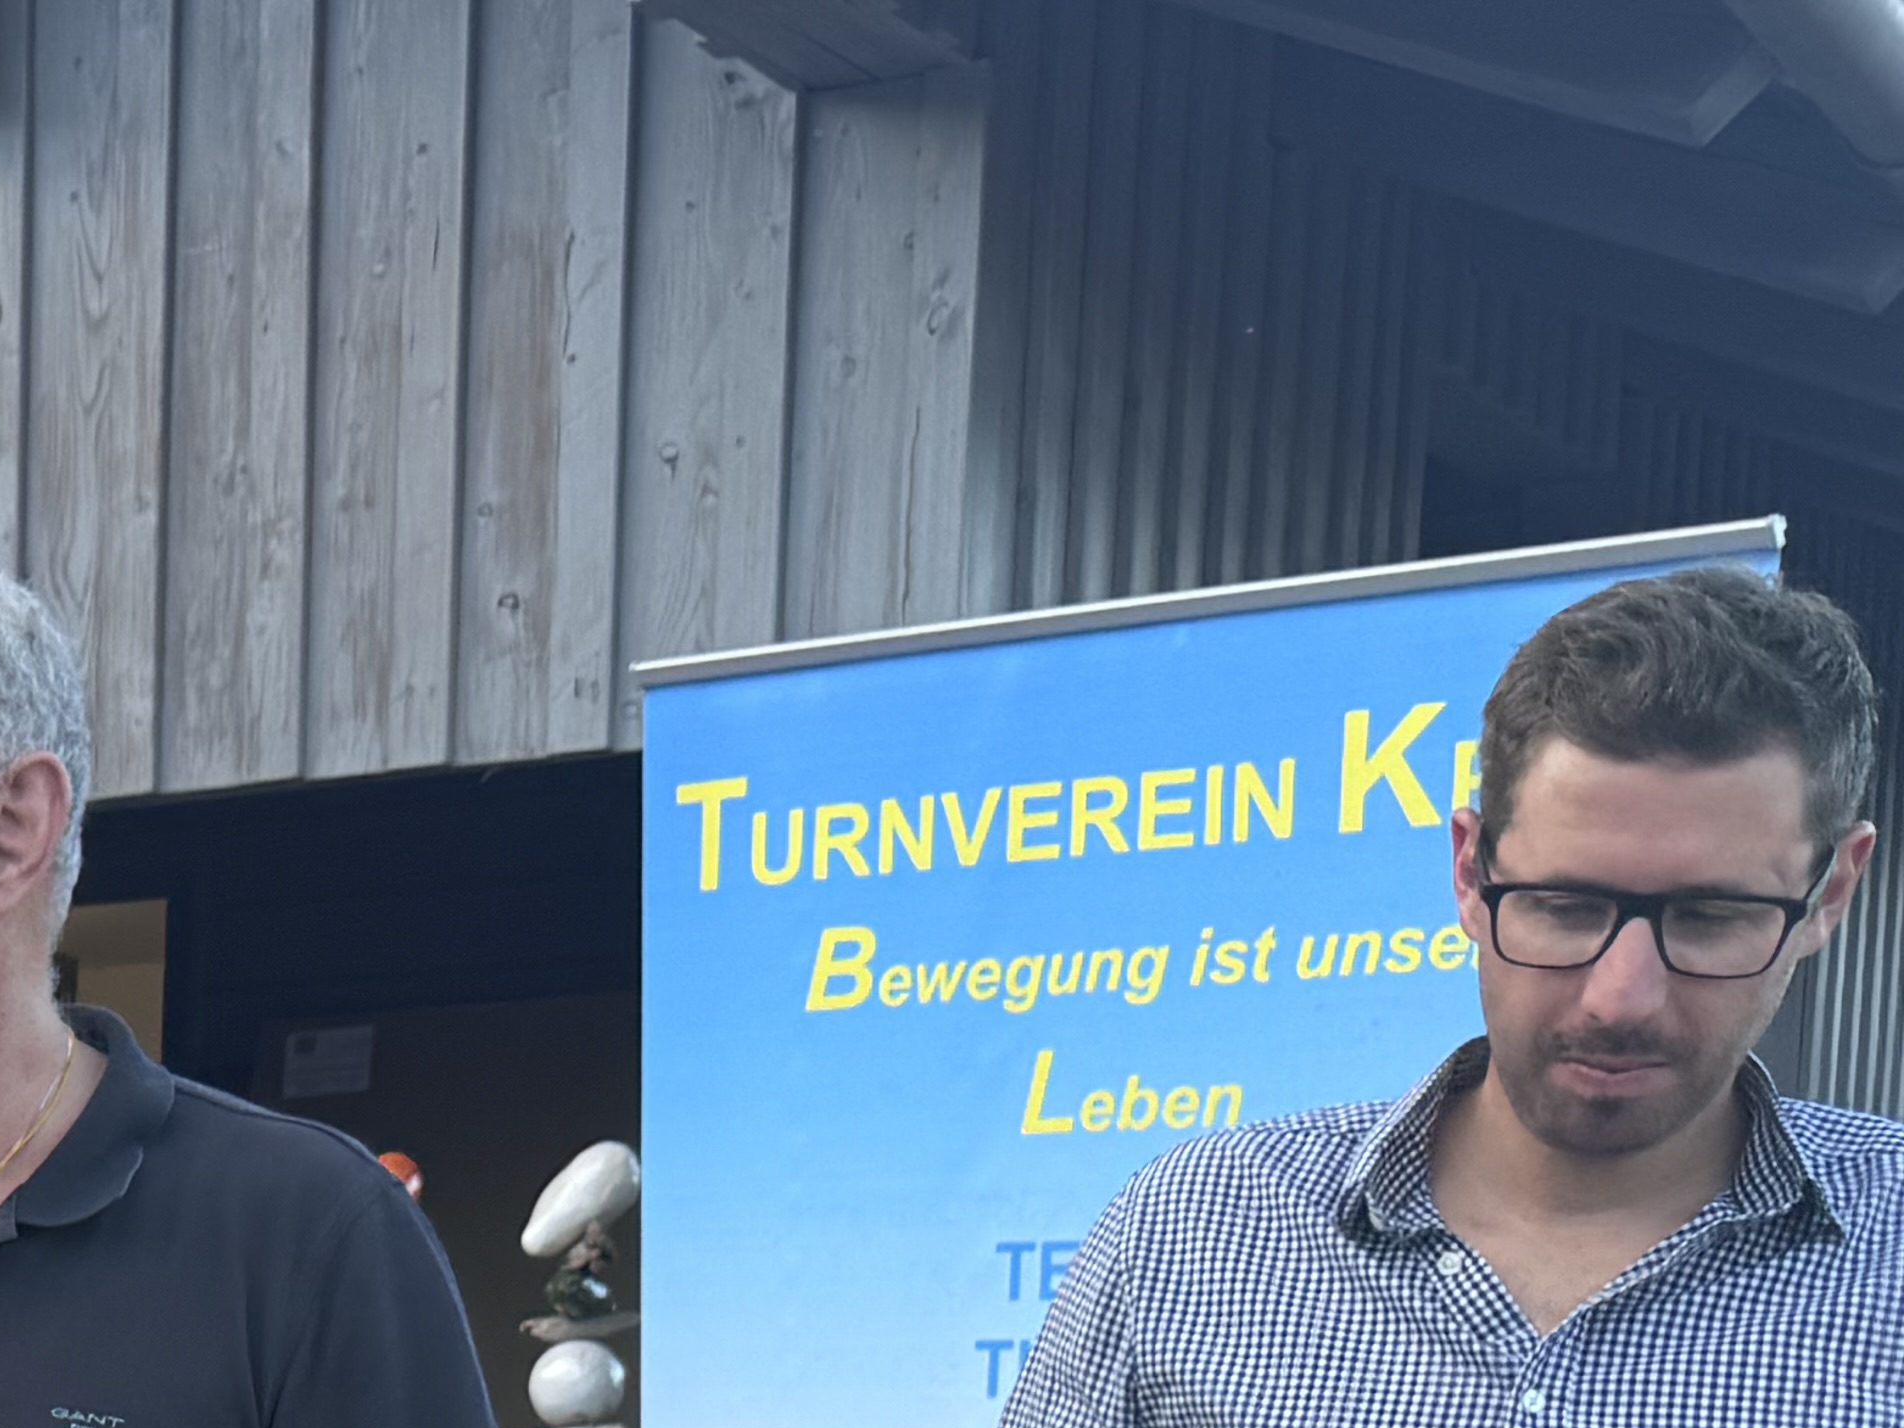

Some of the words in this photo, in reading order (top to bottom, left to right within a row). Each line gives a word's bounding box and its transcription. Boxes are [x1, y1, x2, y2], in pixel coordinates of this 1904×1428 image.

[676, 757, 1298, 892] TURNVEREIN
[805, 924, 1169, 1013] Bewegung
[1190, 927, 1276, 988] ist
[1296, 923, 1480, 980] unse
[1021, 1049, 1244, 1135] Leben
[50, 1406, 126, 1428] GANT
